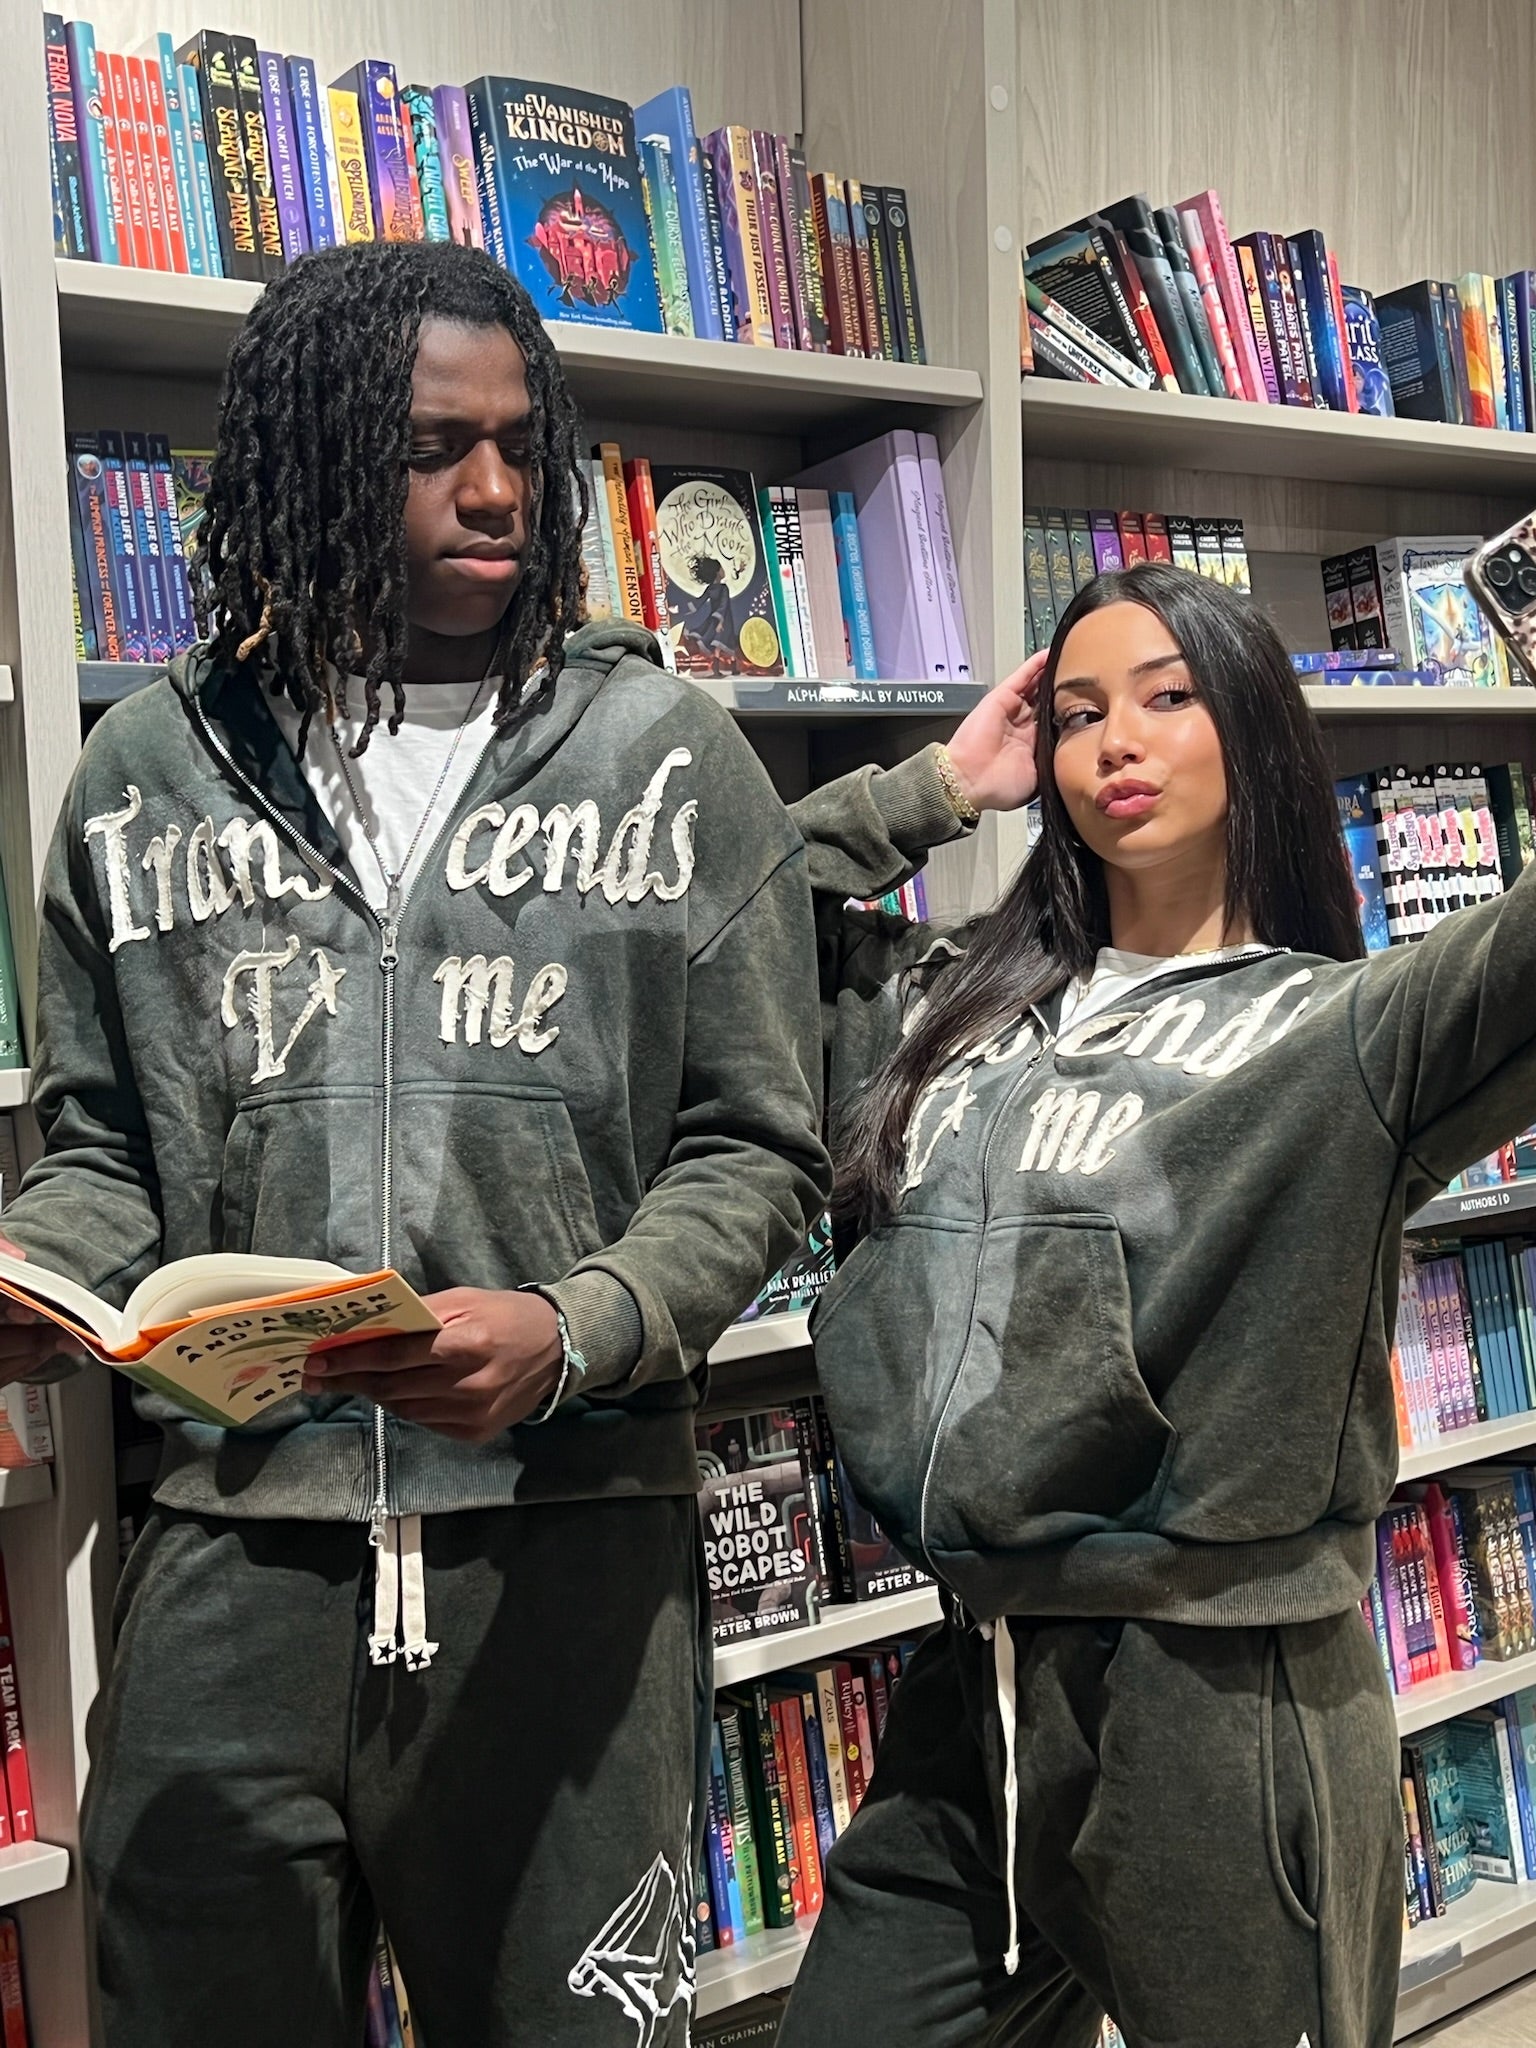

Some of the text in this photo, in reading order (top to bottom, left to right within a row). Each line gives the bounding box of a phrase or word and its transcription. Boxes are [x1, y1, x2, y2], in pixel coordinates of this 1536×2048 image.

[47, 44, 77, 143] TERRA NOVA
[267, 59, 281, 96] CURSE
[503, 93, 624, 136] THE VANISHED
[276, 124, 290, 162] NIGHT
[299, 65, 325, 211] CURSE FORGOTTEN CITY
[505, 115, 627, 158] KINGDOM
[215, 106, 255, 254] SCARING DARING
[281, 164, 294, 201] WITCH
[452, 154, 474, 207] SWEEP
[513, 157, 539, 173] The
[539, 152, 574, 176] War
[575, 161, 585, 171] of
[599, 162, 630, 193] Maps
[256, 196, 283, 257] DARING
[665, 208, 681, 251] CURSE
[745, 198, 757, 236] THEIR
[769, 214, 784, 259] COOKIE
[714, 245, 727, 286] DAVID
[749, 237, 761, 265] JUST
[720, 287, 735, 342] BADDIEL
[811, 277, 825, 319] HERO
[1111, 280, 1138, 339] SISTERHOOD
[1251, 304, 1264, 329] THE
[1269, 299, 1294, 381] MARS PATEL
[1284, 303, 1309, 384] MARS PATEL
[1510, 335, 1522, 373] SONG
[89, 495, 103, 537] PUMPKIN
[114, 471, 134, 557] HAUNTED LIFE OF
[139, 472, 160, 557] HAUNTED LIFE OF
[163, 473, 184, 558] HAUNTED LIFE OF
[668, 488, 732, 518] The Girl
[660, 511, 751, 548] Who Drank
[670, 530, 751, 562] the Moon
[770, 502, 792, 567] BLUME
[785, 501, 806, 561] BLUME
[95, 536, 109, 579] PRINCESS
[102, 590, 116, 633] FOREVER
[624, 566, 642, 618] HENSON
[787, 688, 945, 704] ALPHACAL BY AUTHOR
[445, 747, 699, 905] cends
[1403, 812, 1421, 870] DISASTERS
[432, 954, 568, 1054] me
[1016, 1088, 1144, 1177] me
[1460, 1192, 1511, 1212] AUTHORS D
[766, 1277, 790, 1294] MAX
[176, 1292, 388, 1356] A GUARDIAN
[188, 1332, 248, 1364] AND
[263, 1326, 280, 1334] A
[713, 1481, 764, 1509] THE
[709, 1502, 778, 1537] WILD
[832, 1508, 848, 1569] ROBOT
[704, 1524, 787, 1567] ROBOT
[707, 1548, 806, 1591] SCAPES
[867, 1572, 912, 1595] PETER
[1455, 1535, 1479, 1638] THE FACTORY
[712, 1609, 800, 1640] PETER BROWN
[1429, 1585, 1443, 1621] FLICKER
[0, 1663, 23, 1753] TEAM PARK
[823, 1687, 836, 1723] Zeus
[841, 1681, 855, 1720] Ripley
[734, 1808, 752, 1846] LIVES
[770, 1797, 782, 1819] WAY
[803, 1822, 814, 1853] FALLS
[807, 1854, 817, 1884] AGAIN
[718, 2020, 778, 2047] CHAINANI
